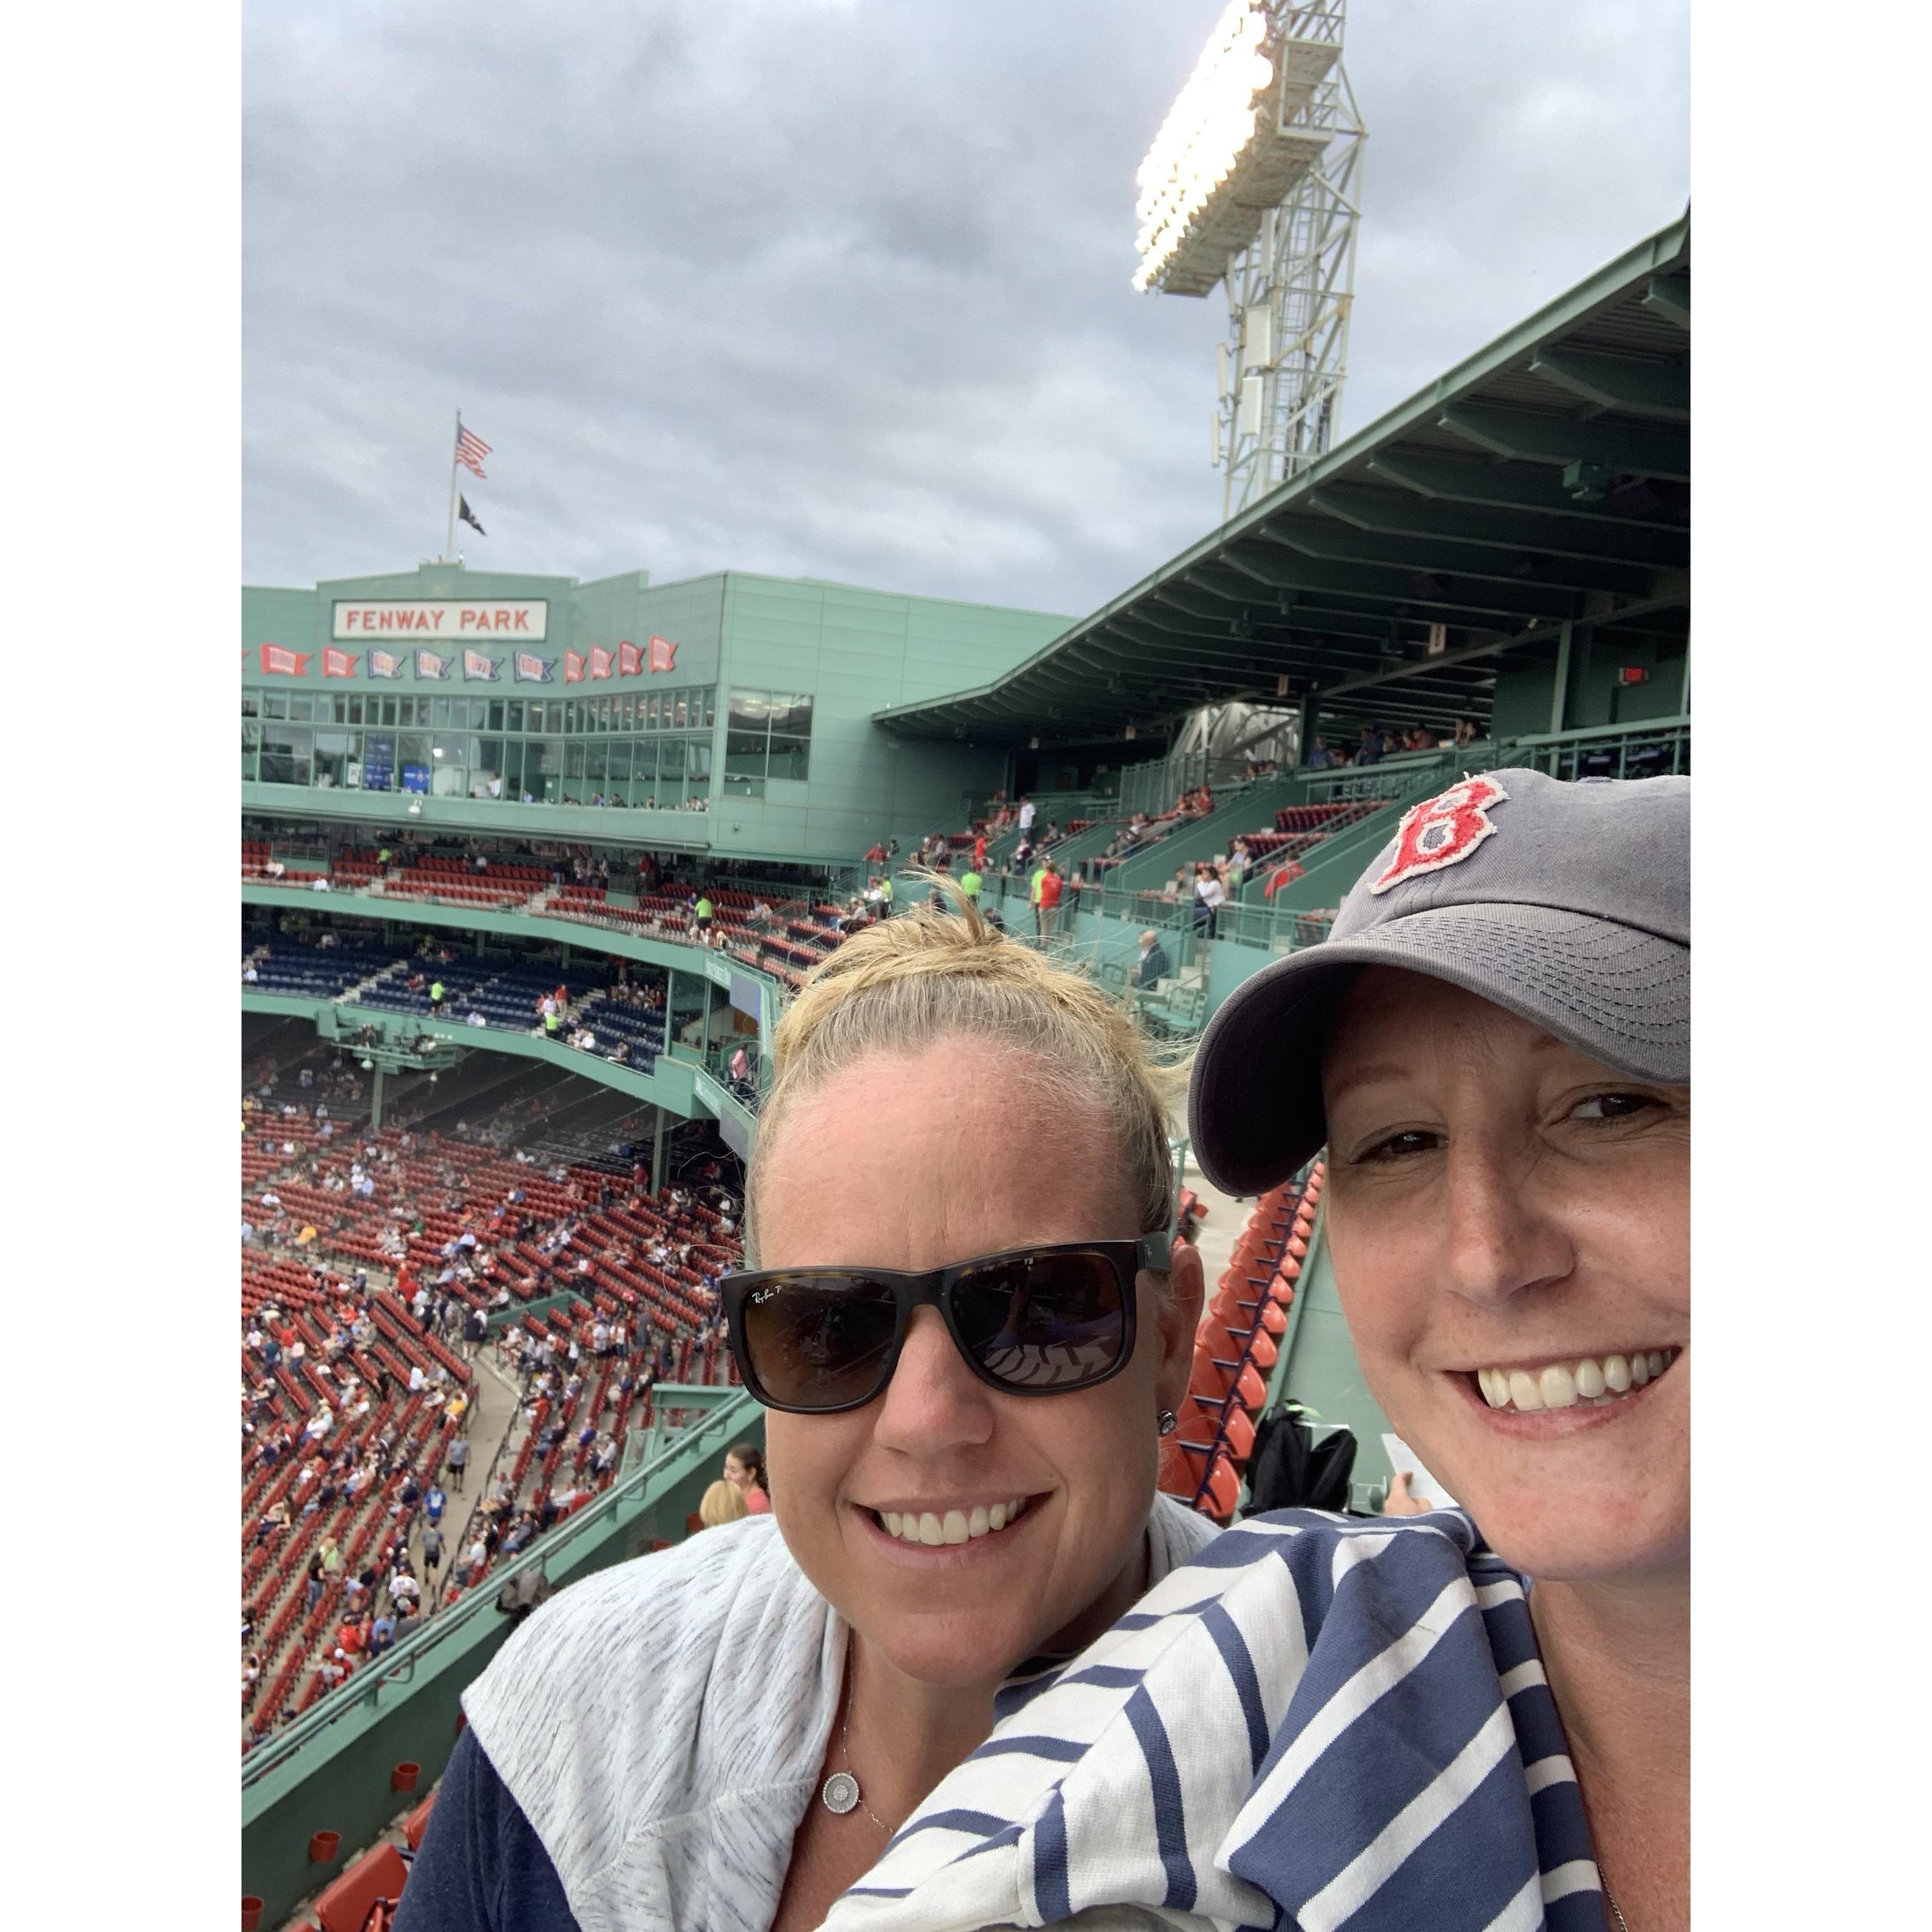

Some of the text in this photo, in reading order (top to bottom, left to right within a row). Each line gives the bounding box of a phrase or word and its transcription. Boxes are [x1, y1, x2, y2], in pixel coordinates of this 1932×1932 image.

[347, 609, 531, 631] FENWAY PARK
[1368, 775, 1509, 895] B
